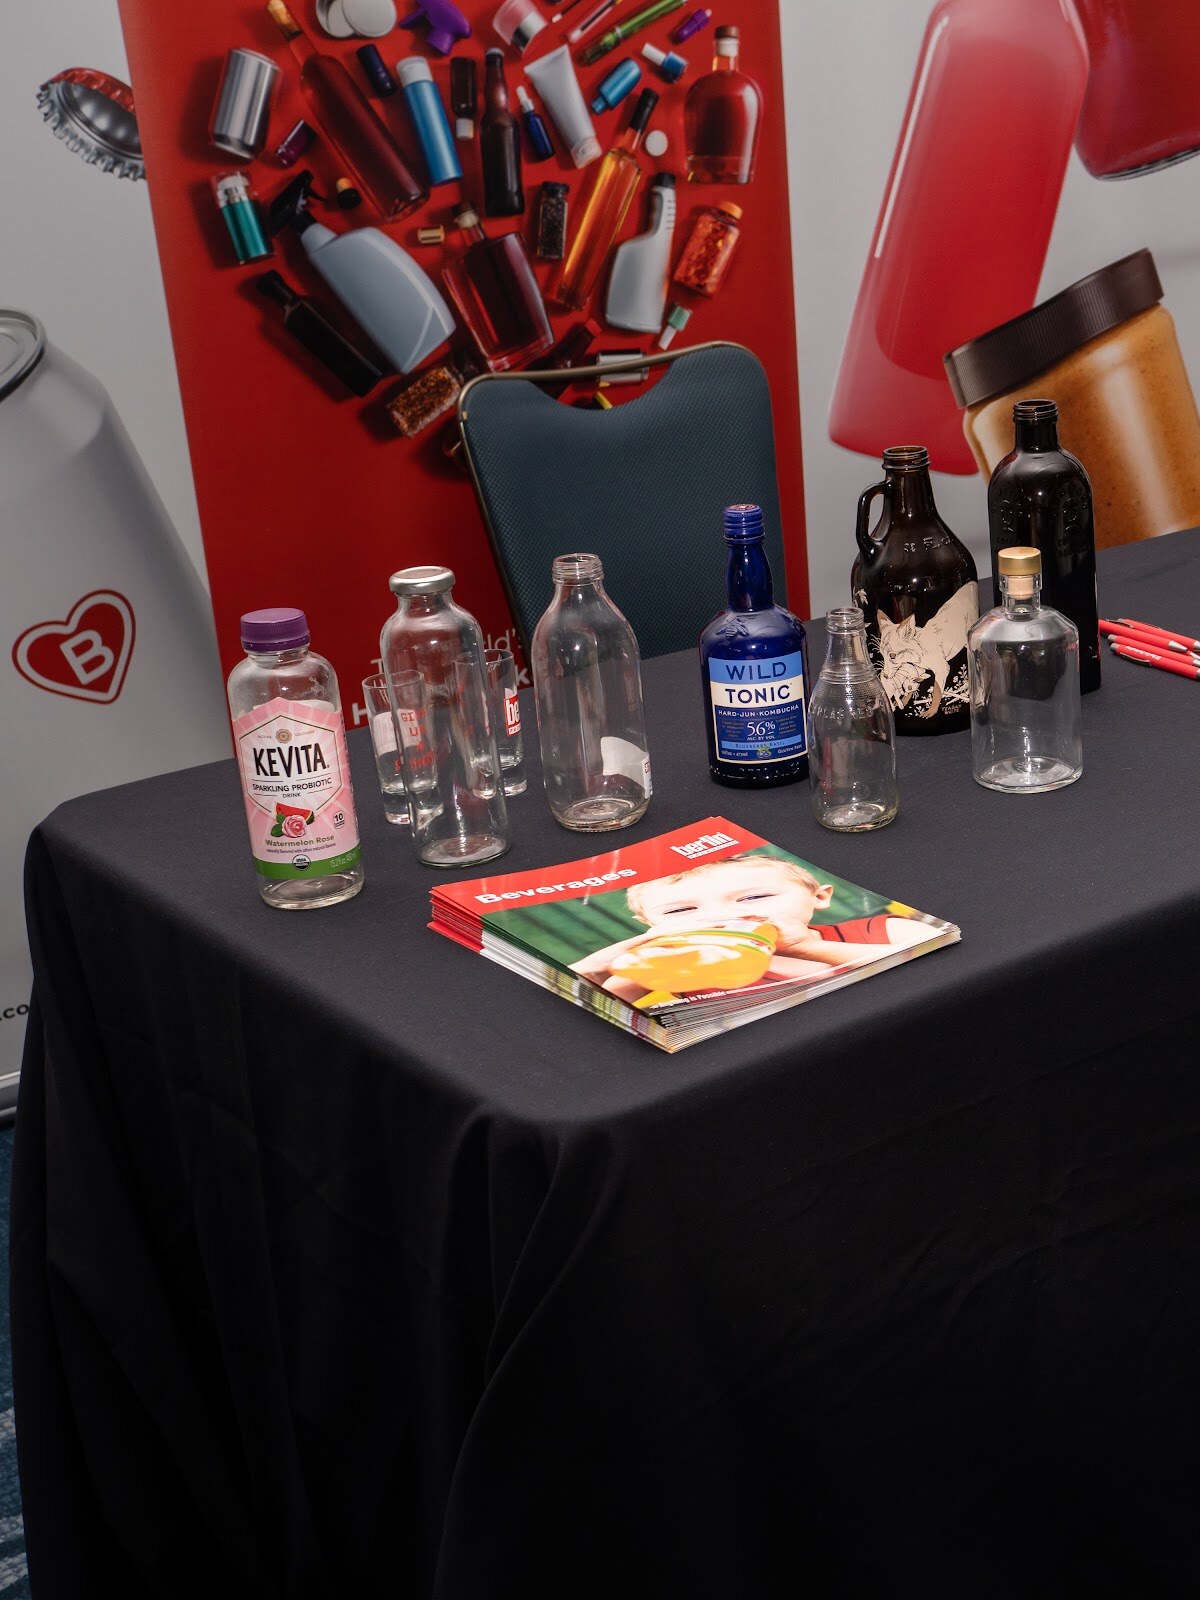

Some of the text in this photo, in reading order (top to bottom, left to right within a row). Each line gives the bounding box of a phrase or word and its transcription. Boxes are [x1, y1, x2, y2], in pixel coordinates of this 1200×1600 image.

[60, 627, 116, 685] B
[726, 662, 786, 680] WILD
[725, 685, 790, 704] TONIC
[253, 743, 327, 778] KEVITA
[252, 778, 332, 792] SPARKLING PROBIOTIC
[334, 813, 344, 821] 10
[265, 835, 335, 847] Watermelon Rose
[670, 831, 734, 856] berlin
[474, 867, 638, 904] Beverages
